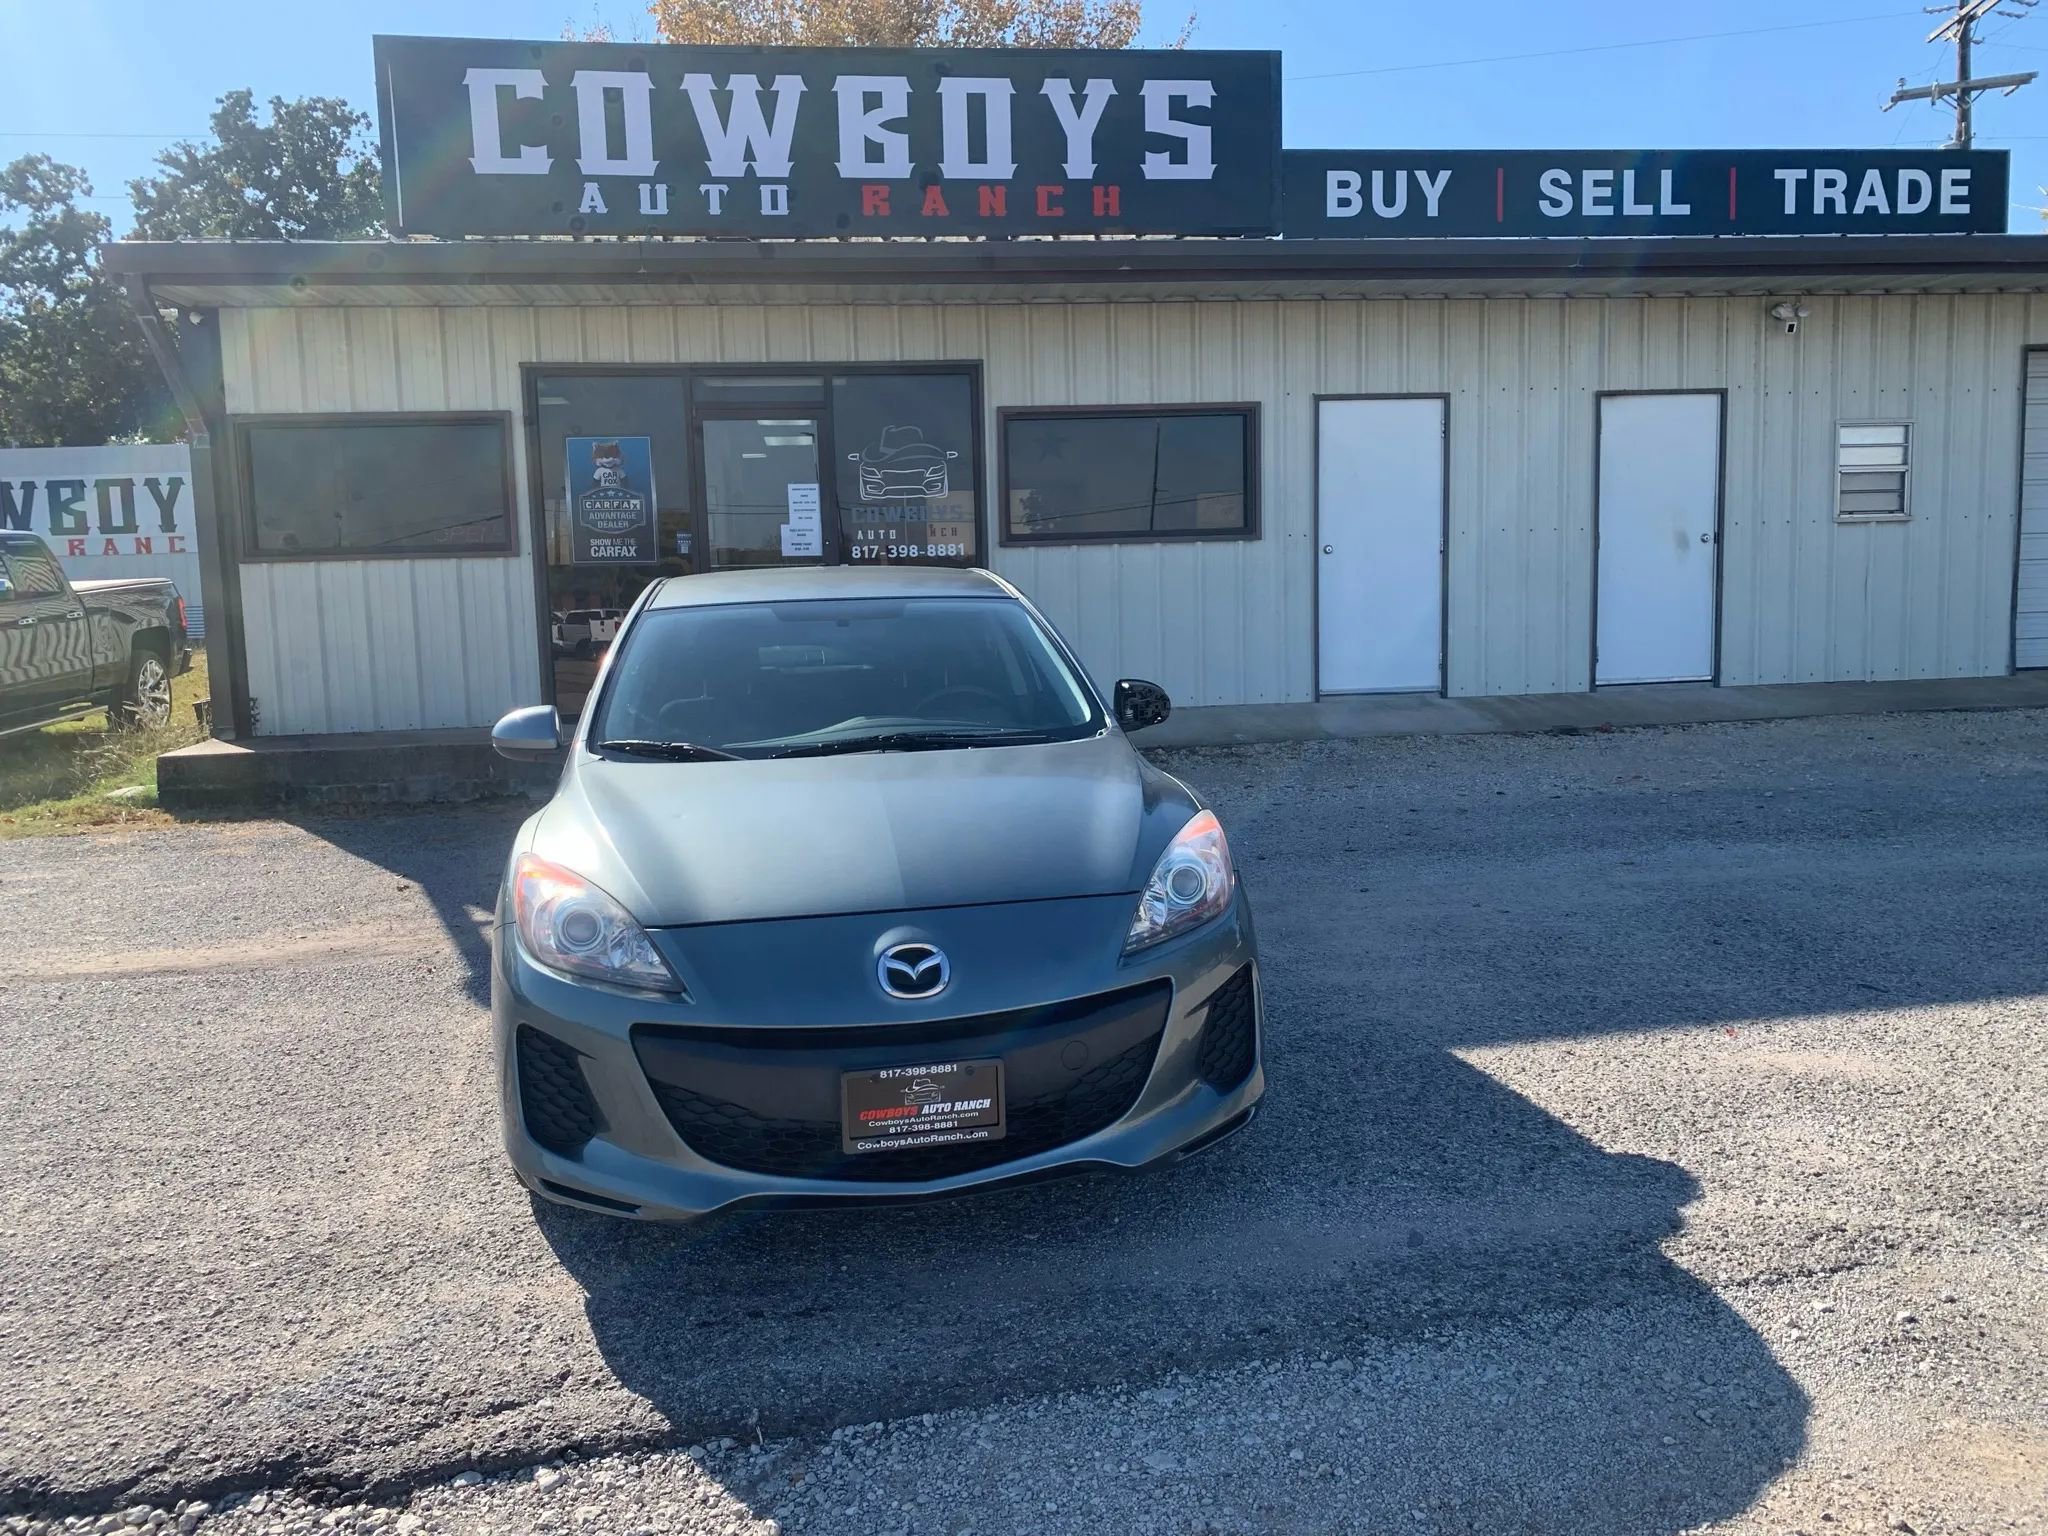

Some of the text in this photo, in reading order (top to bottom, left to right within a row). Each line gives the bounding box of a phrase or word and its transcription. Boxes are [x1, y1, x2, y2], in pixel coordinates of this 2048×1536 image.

[462, 67, 1218, 180] COWBOYS
[579, 182, 1121, 217] AUTO RANCH
[1326, 168, 1971, 217] BUY SELL TRADE
[602, 471, 618, 479] CAR
[585, 501, 640, 509] CARFAX
[589, 512, 638, 520] ADVANTAGE
[591, 538, 611, 546] SHOW
[857, 530, 896, 540] AUTO
[591, 546, 637, 557] CARFAX
[852, 543, 965, 558] 817-398-8881
[880, 1064, 958, 1079] 817-398-8881
[859, 1098, 992, 1121] COWBOYS AUTO RANCH
[868, 1111, 979, 1127] CowboysAutoRanch.com
[889, 1121, 958, 1134] 817-398-8881
[857, 1130, 988, 1150] CowboysAutoRanch.com
